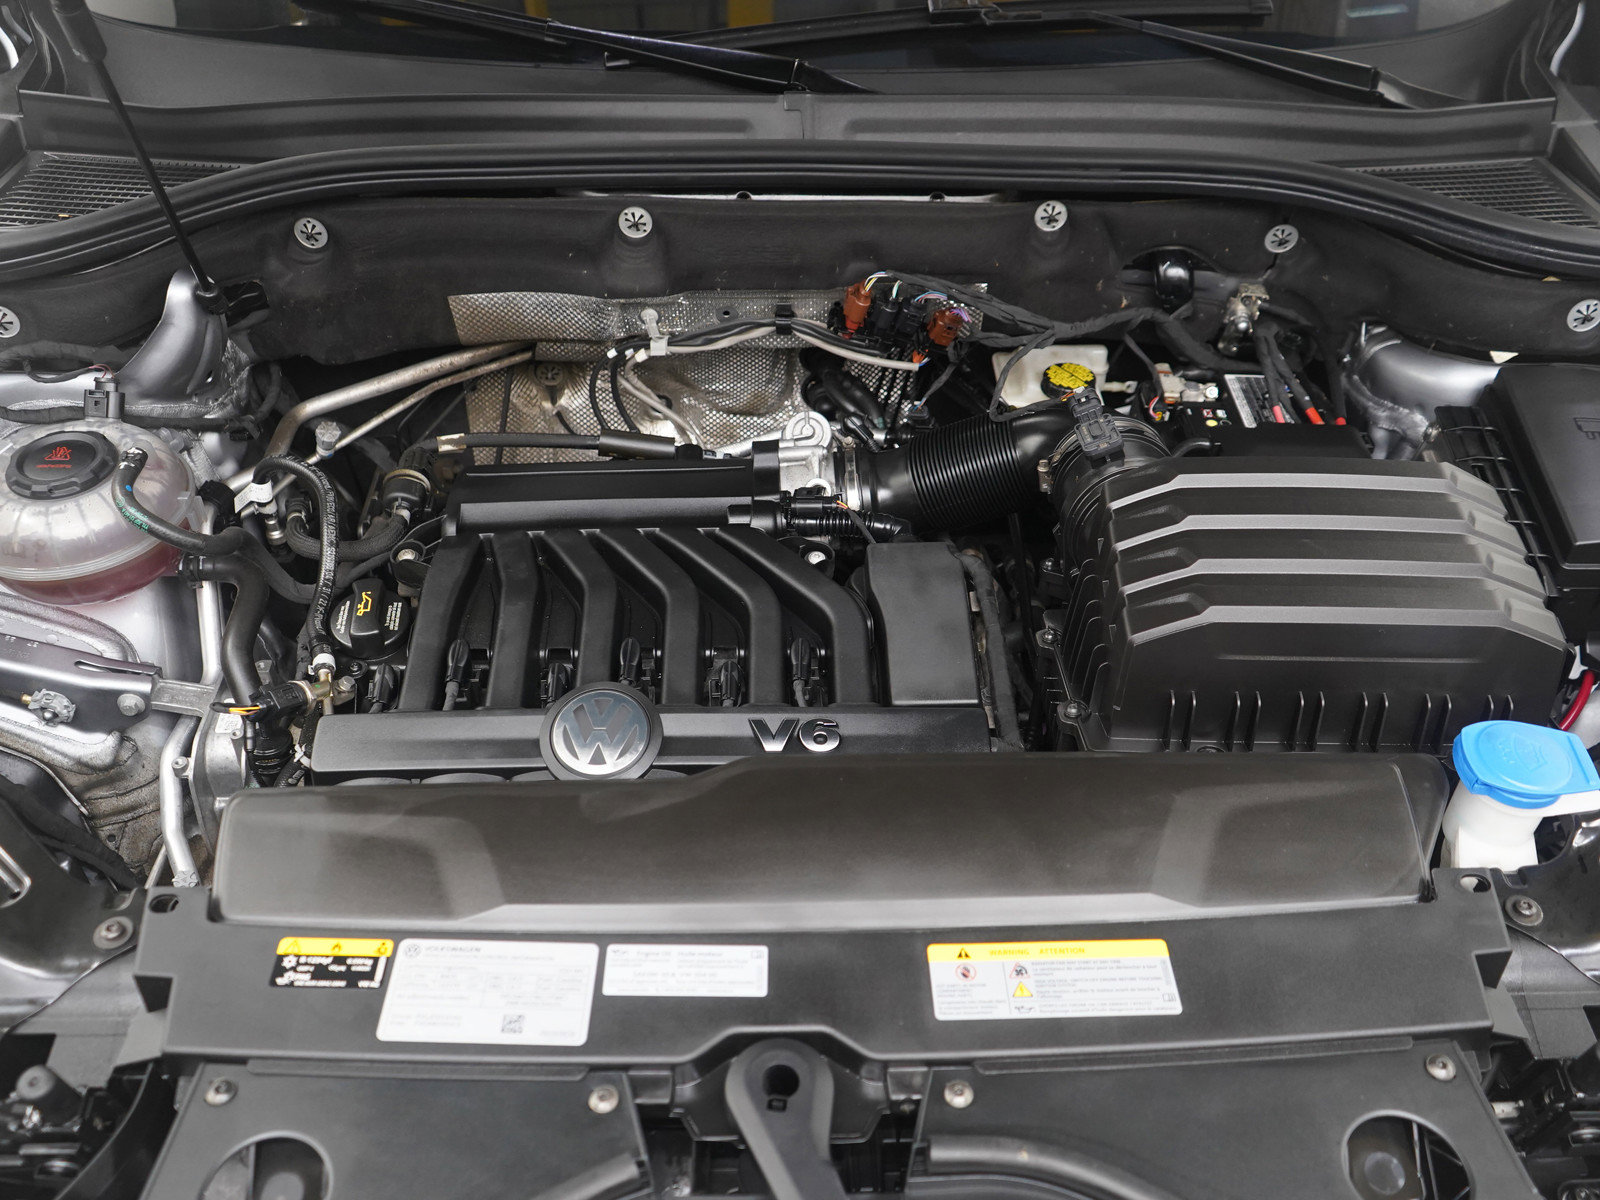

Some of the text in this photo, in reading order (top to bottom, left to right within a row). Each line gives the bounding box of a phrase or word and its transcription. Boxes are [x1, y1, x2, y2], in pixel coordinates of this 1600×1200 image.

[748, 718, 841, 752] V6
[989, 947, 1085, 956] WARNING ATTENTION
